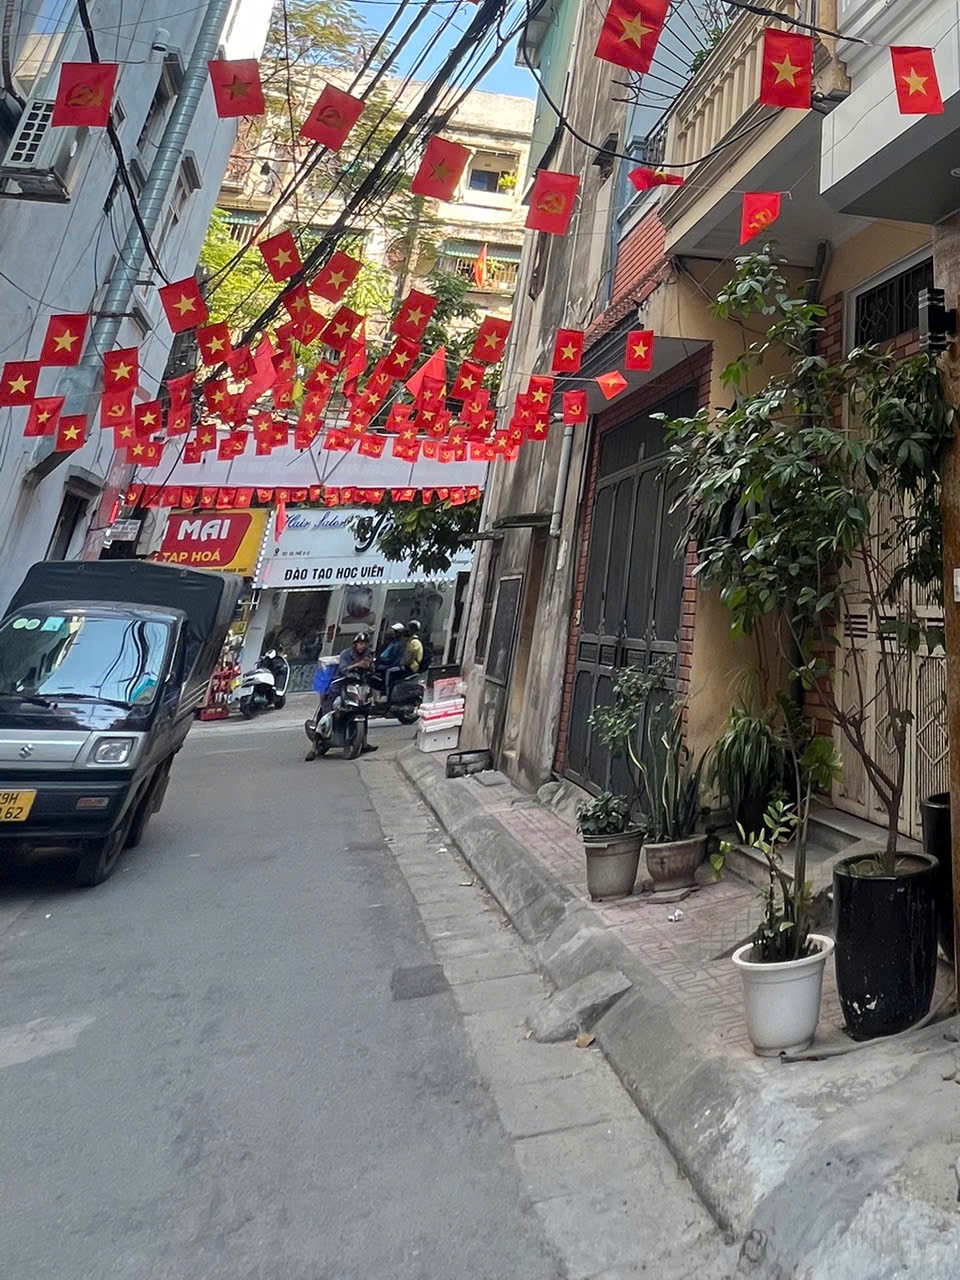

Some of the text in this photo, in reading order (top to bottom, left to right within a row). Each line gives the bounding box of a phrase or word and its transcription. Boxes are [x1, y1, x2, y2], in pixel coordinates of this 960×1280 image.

[177, 519, 231, 542] MAI
[191, 548, 221, 562] HOÁ
[284, 564, 384, 582] ĐÀO TẠO HỌC VIÊN
[0, 793, 19, 805] 9H
